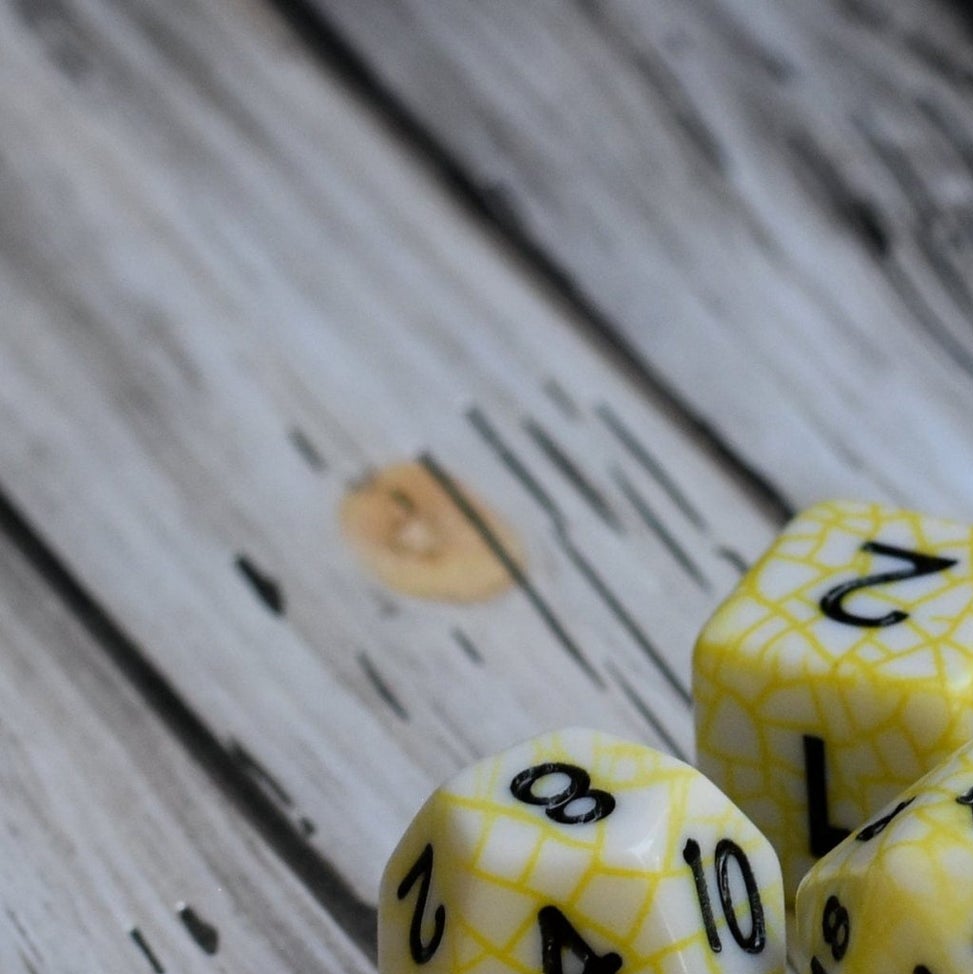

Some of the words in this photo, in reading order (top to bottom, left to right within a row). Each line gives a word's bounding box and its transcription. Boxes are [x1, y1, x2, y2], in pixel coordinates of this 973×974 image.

[820, 541, 958, 627] 2
[510, 762, 615, 824] 8
[398, 843, 446, 965] 2
[683, 839, 765, 953] 10
